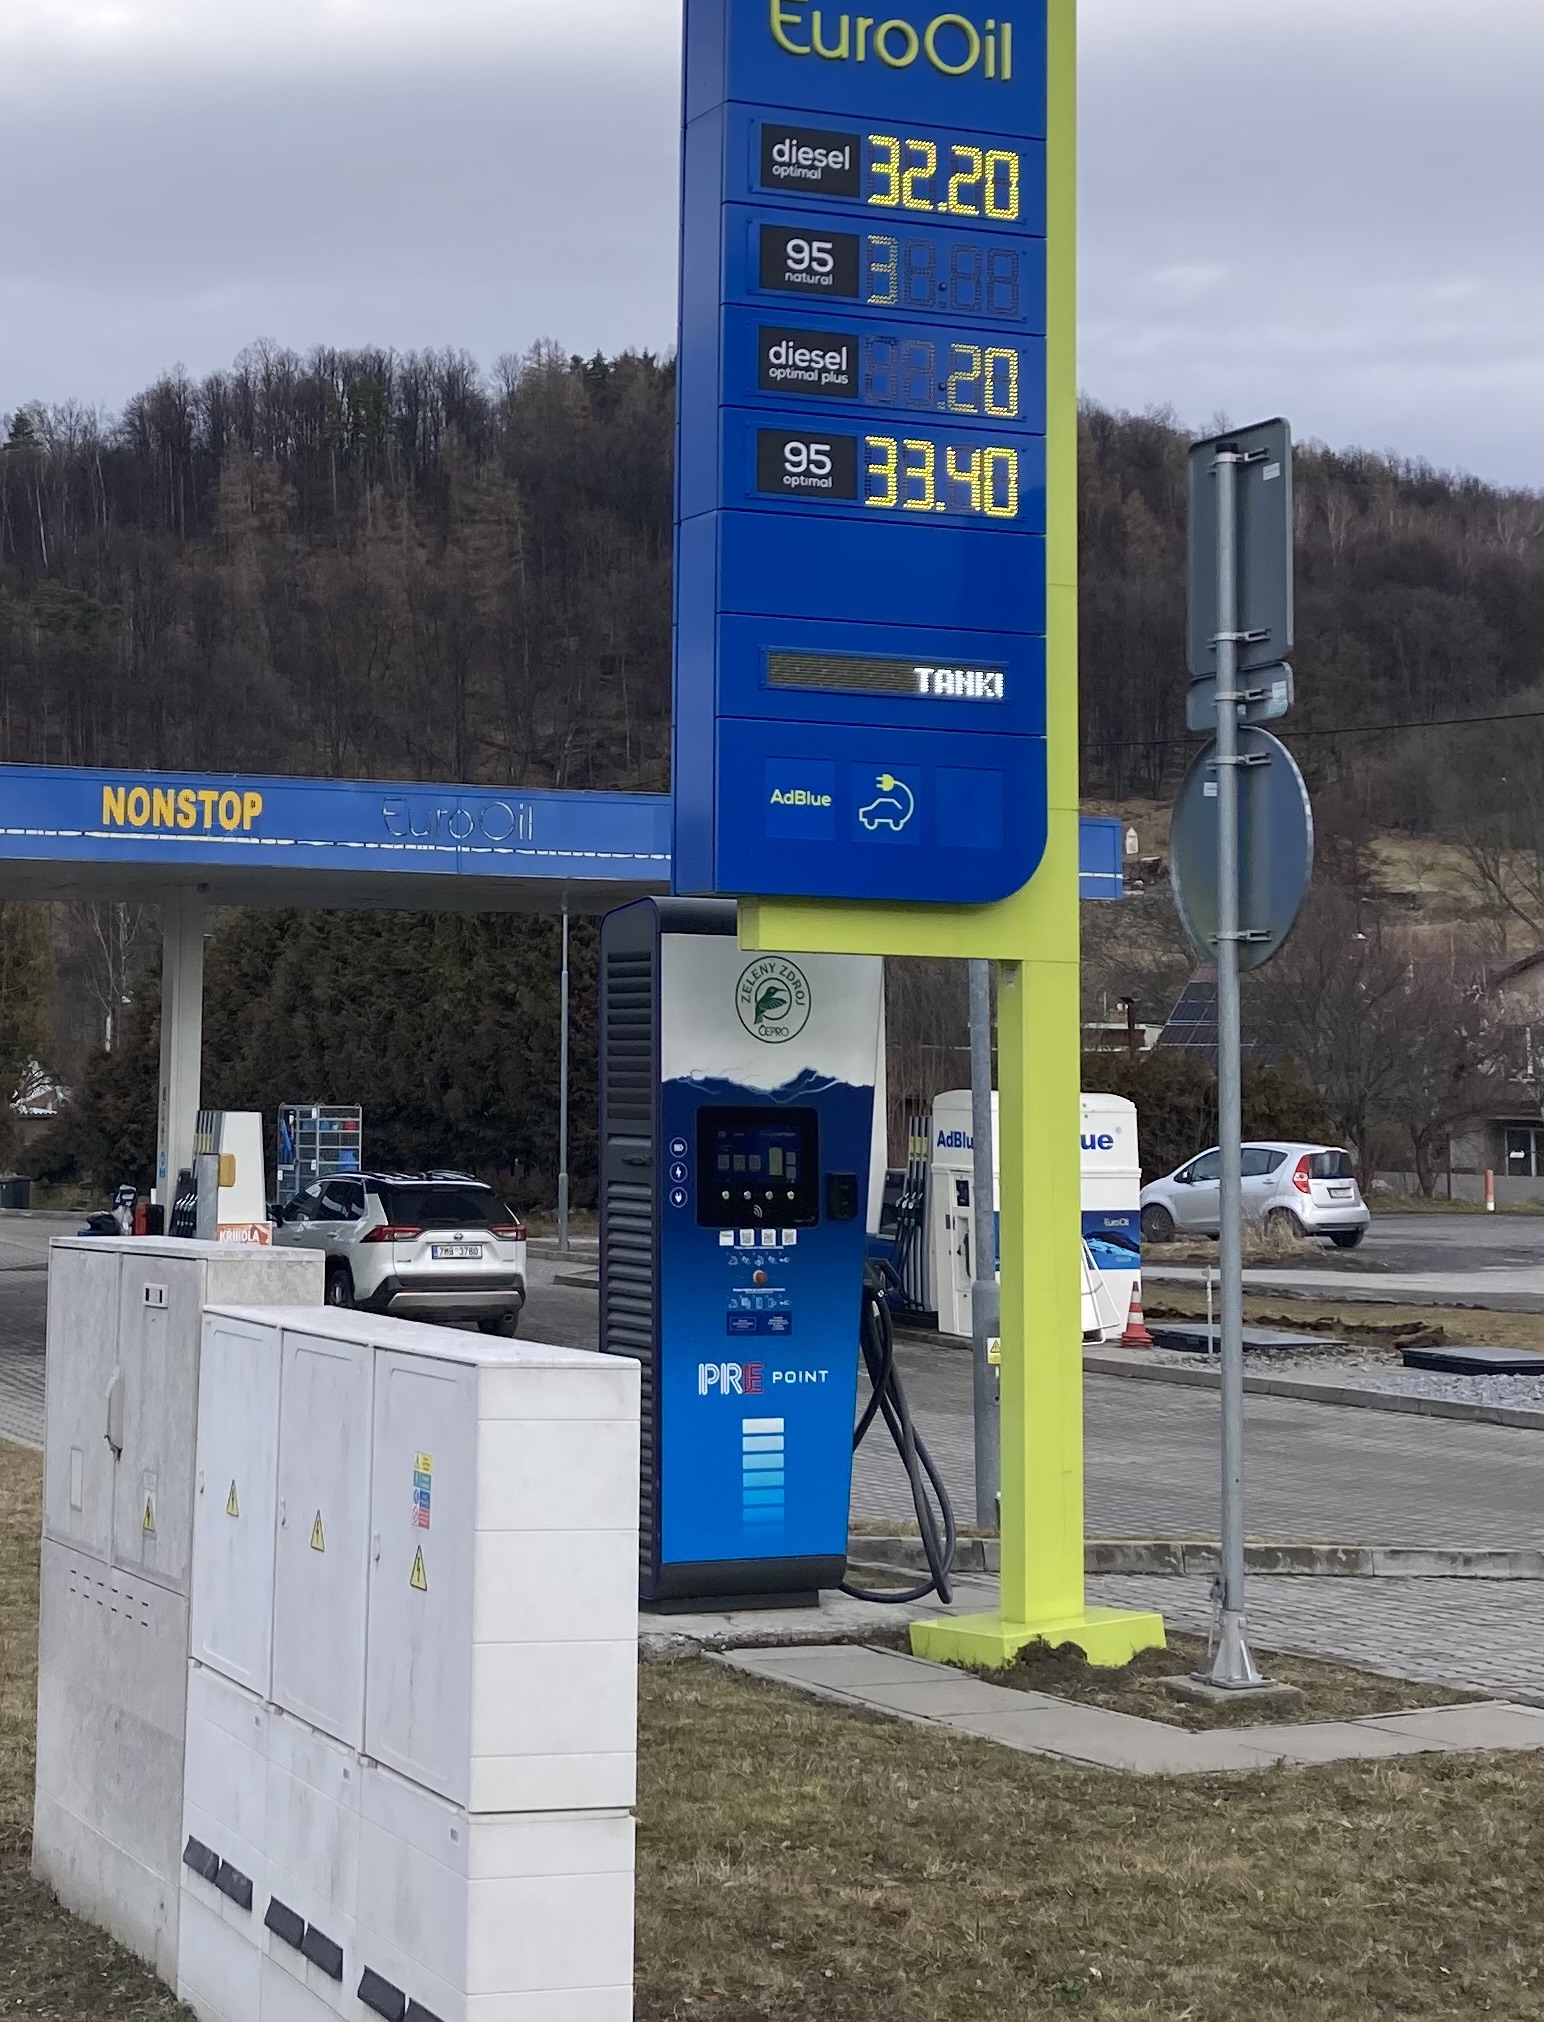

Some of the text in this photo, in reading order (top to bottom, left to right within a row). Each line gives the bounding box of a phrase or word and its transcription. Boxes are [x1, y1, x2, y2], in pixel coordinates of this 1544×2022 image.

[770, 0, 1012, 81] EuroOil
[772, 138, 851, 170] diesel
[772, 164, 822, 180] optimal
[867, 134, 1020, 220] 32.20
[786, 238, 834, 273] 95
[784, 271, 834, 285] natural
[768, 340, 848, 371] diesel
[768, 367, 849, 385] optimal plus
[784, 441, 832, 475] 95
[783, 475, 833, 488] optimal
[865, 436, 1019, 517] 33.40
[102, 784, 263, 831] NONSTOP
[770, 788, 832, 807] AdBlue
[382, 797, 534, 841] EuroOil
[778, 965, 806, 1006] ZDROJ
[758, 1024, 790, 1038] ČEPRO
[936, 1129, 975, 1149] AdBlu
[698, 1360, 829, 1396] PRE POINT
